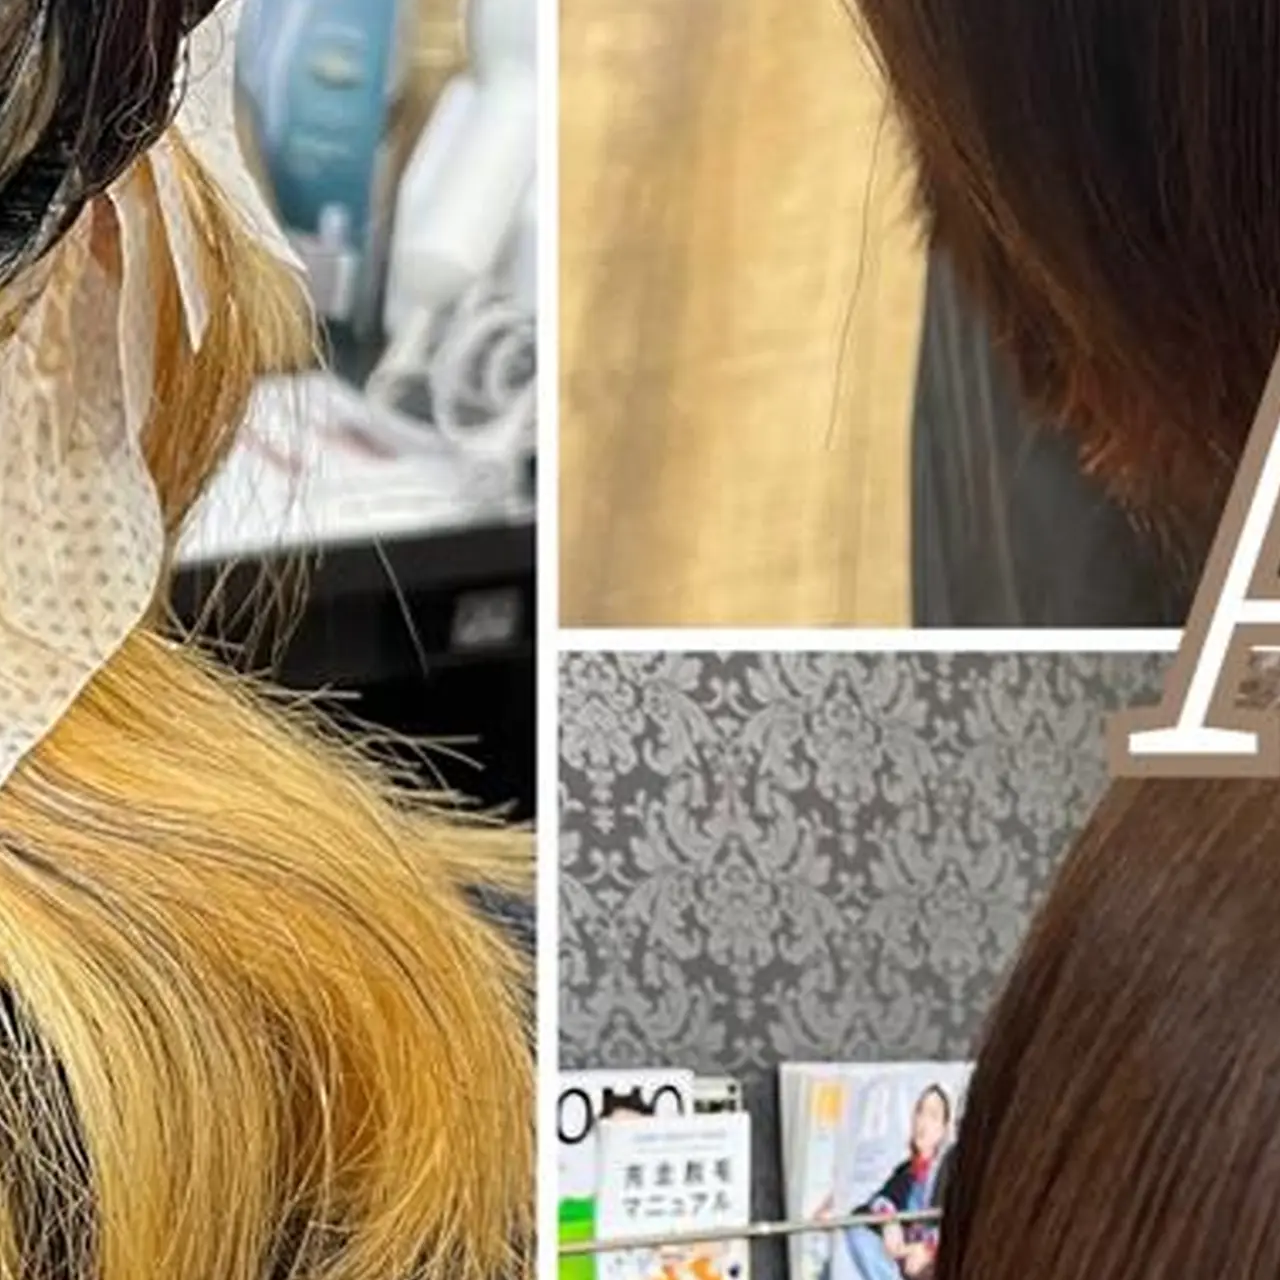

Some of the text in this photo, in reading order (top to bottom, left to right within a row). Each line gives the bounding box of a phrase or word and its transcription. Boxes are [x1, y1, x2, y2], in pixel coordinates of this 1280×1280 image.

[622, 1189, 732, 1218] マニュアル
